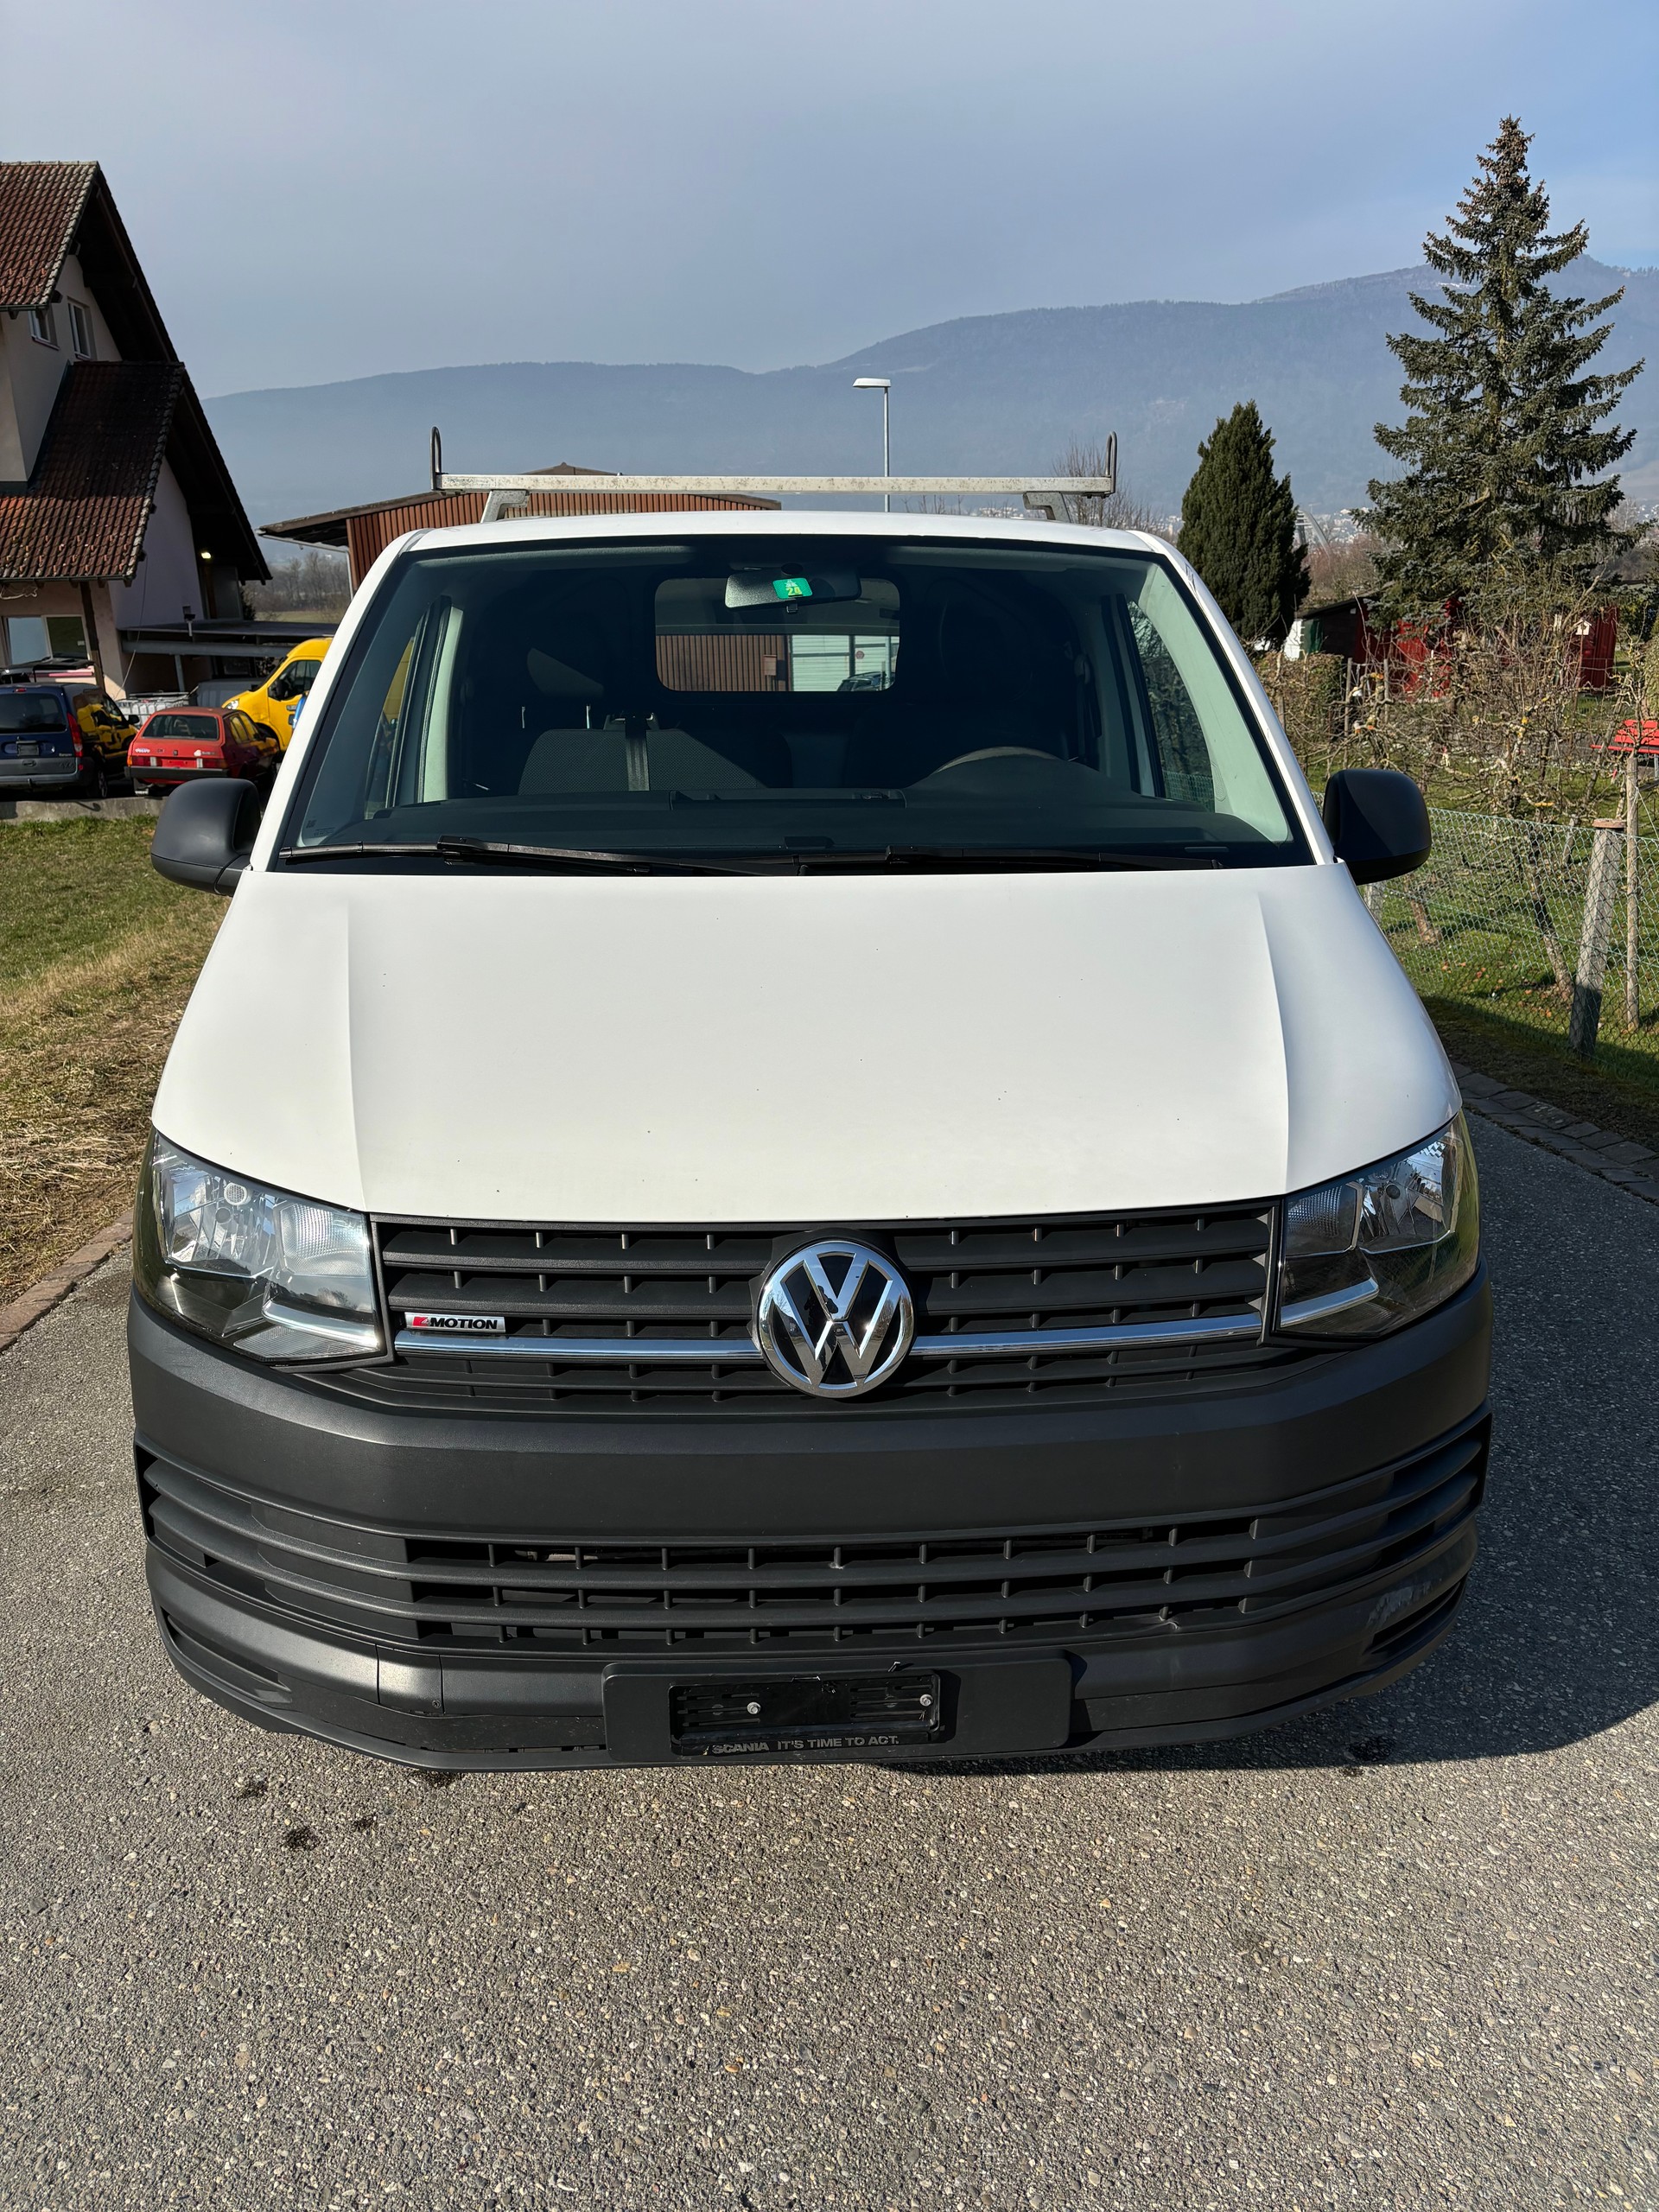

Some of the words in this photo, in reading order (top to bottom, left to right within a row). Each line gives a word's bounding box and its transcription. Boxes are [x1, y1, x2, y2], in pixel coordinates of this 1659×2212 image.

[712, 1742, 769, 1754] SCANIA
[777, 1739, 804, 1750] IT'S
[807, 1738, 842, 1748] TIME
[845, 1737, 866, 1746] TO
[868, 1735, 899, 1745] ACT.
